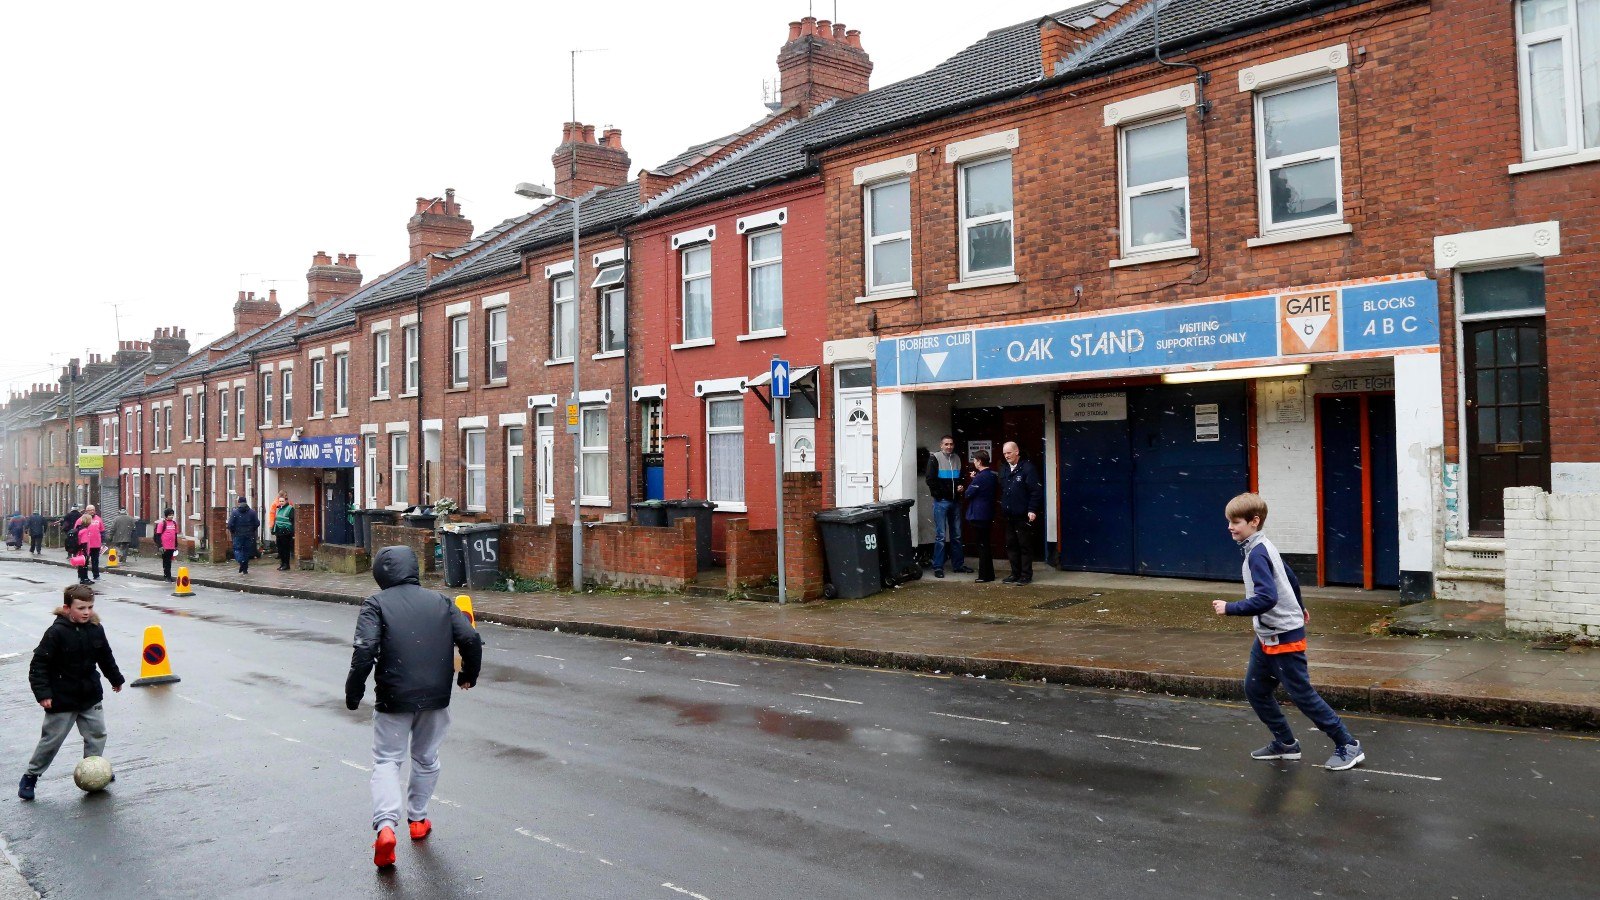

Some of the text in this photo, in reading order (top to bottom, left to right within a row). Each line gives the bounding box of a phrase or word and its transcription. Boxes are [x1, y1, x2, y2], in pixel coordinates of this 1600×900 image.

[1286, 295, 1331, 315] GATE
[1363, 296, 1415, 312] BLOCKS
[1179, 320, 1220, 334] VISITING
[1363, 315, 1418, 336] A B C
[899, 332, 971, 351] BOBBERS CLUB
[1006, 328, 1145, 362] OAK STAND
[1156, 332, 1246, 350] SUPPORTERS ONLY
[1331, 379, 1358, 391] GATE
[334, 437, 343, 445] GATE
[284, 445, 298, 460] OAK
[299, 444, 320, 460] STAND
[345, 448, 357, 463] D-E
[473, 537, 499, 562] 95
[864, 533, 877, 550] 99
